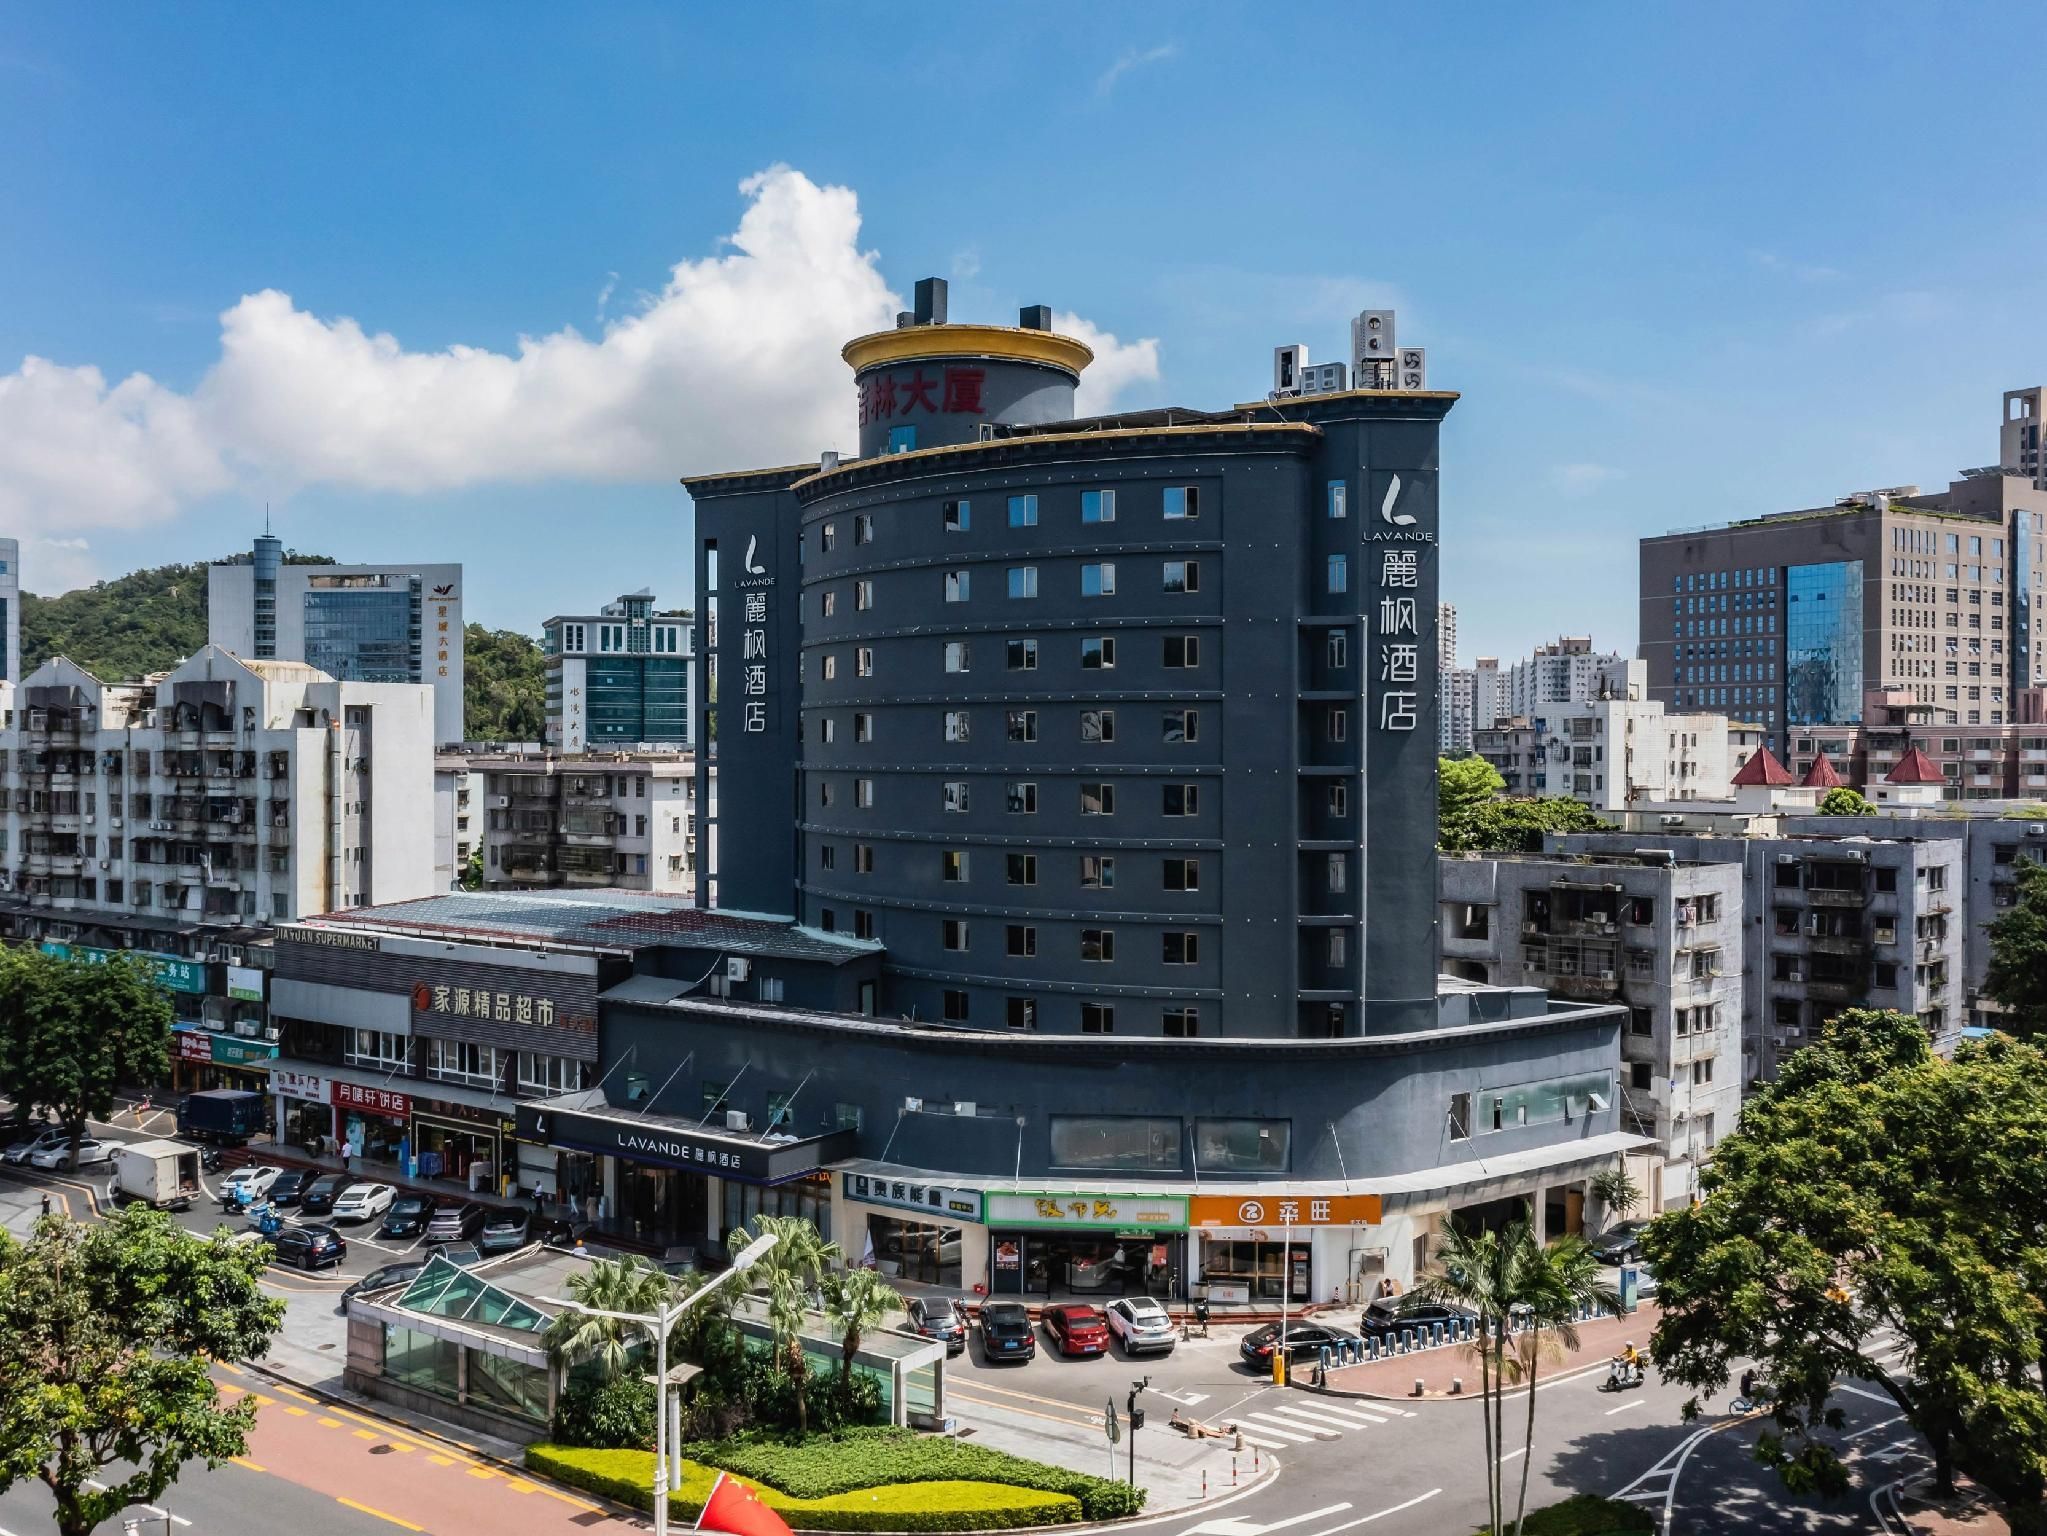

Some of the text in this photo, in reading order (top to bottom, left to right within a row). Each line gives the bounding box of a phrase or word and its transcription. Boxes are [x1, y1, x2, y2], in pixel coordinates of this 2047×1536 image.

[1363, 531, 1433, 542] LAVANDE
[735, 577, 776, 588] LAVANDE
[1380, 550, 1418, 731] 麗枫酒店
[743, 592, 767, 733] 麗枫酒店
[315, 932, 378, 950] SUPERMARKET
[434, 984, 554, 1027] 家源精品超市
[617, 1133, 690, 1159] LAVANDE
